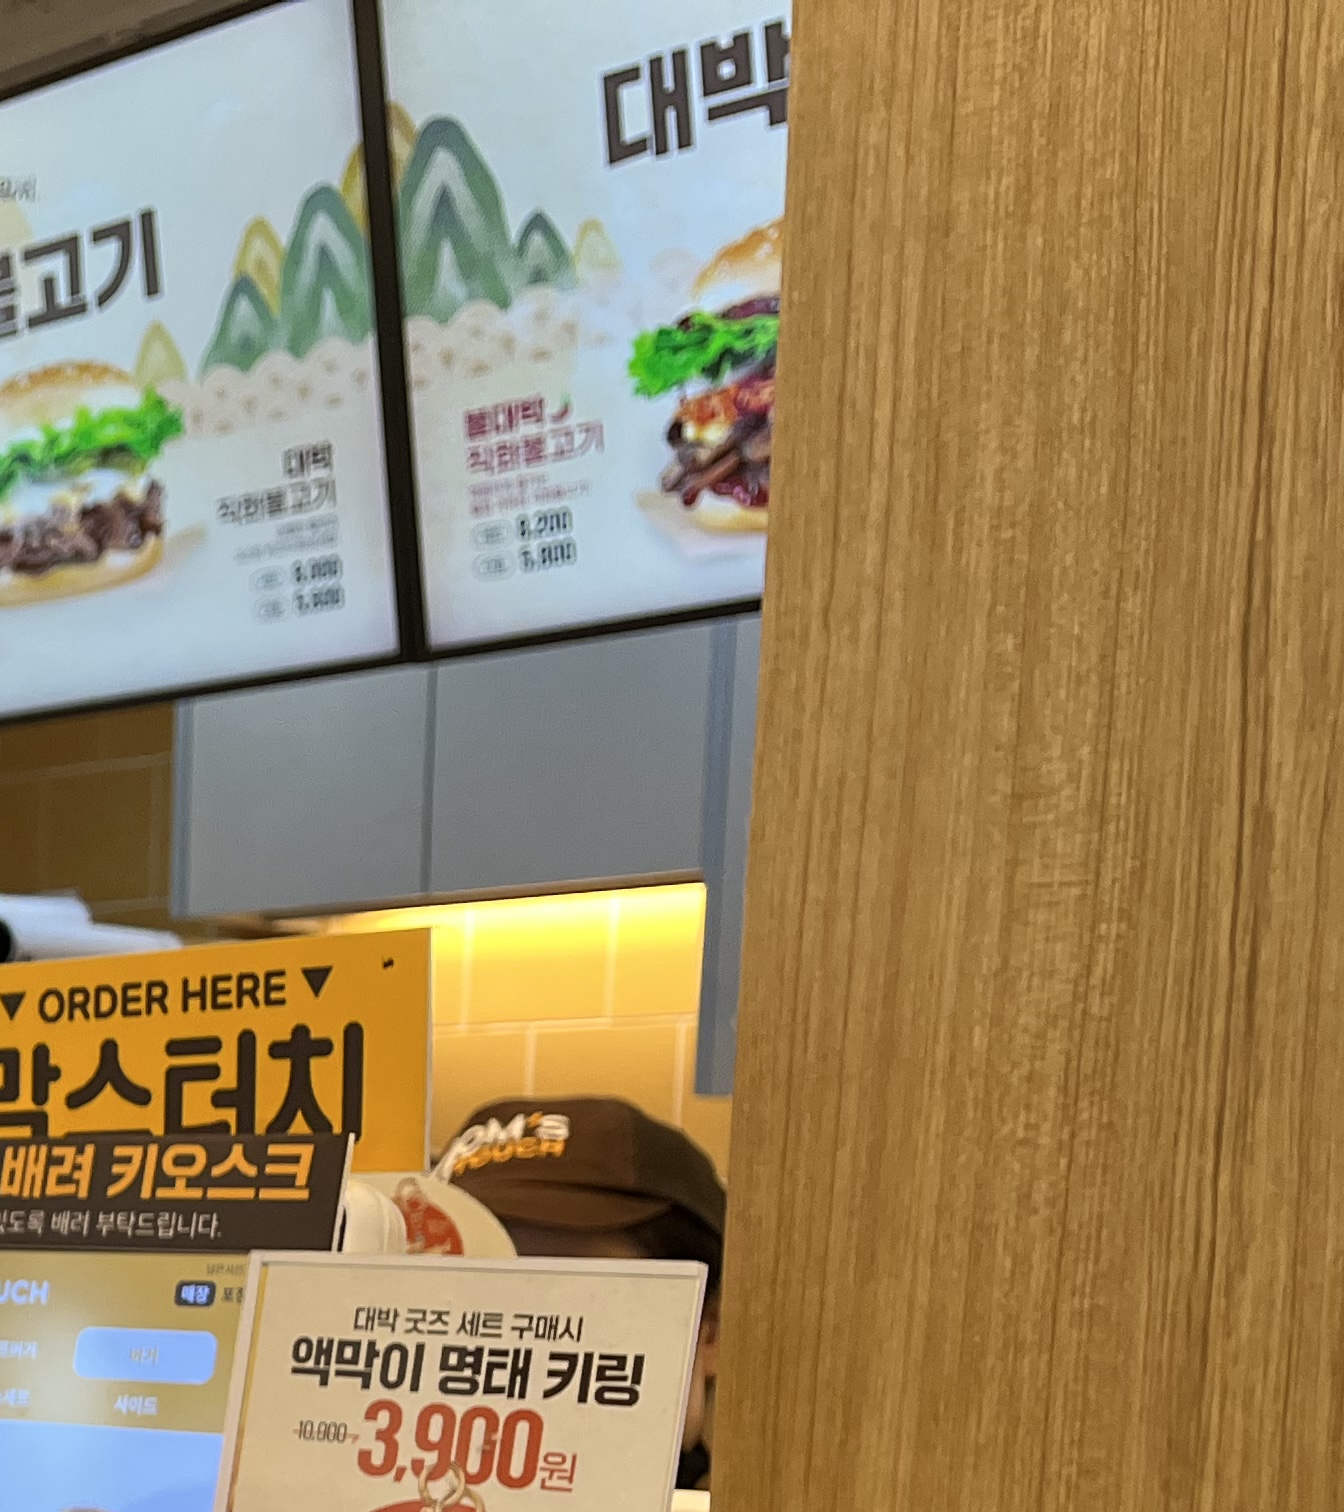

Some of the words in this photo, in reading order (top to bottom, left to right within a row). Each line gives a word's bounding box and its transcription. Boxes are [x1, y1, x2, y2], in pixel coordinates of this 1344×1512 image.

[37, 977, 169, 1023] ORDER
[180, 968, 288, 1014] HERE
[110, 1142, 315, 1201] 키오스크
[96, 1209, 223, 1240] 부탁드립니다.
[180, 1283, 211, 1305] 매장
[353, 1306, 400, 1334] 대박
[405, 1308, 450, 1336] 굿즈
[457, 1311, 504, 1339] 세트
[510, 1314, 584, 1342] 구매시
[290, 1336, 424, 1393] 액막이
[438, 1343, 527, 1399] 명태
[541, 1351, 646, 1407] 키링
